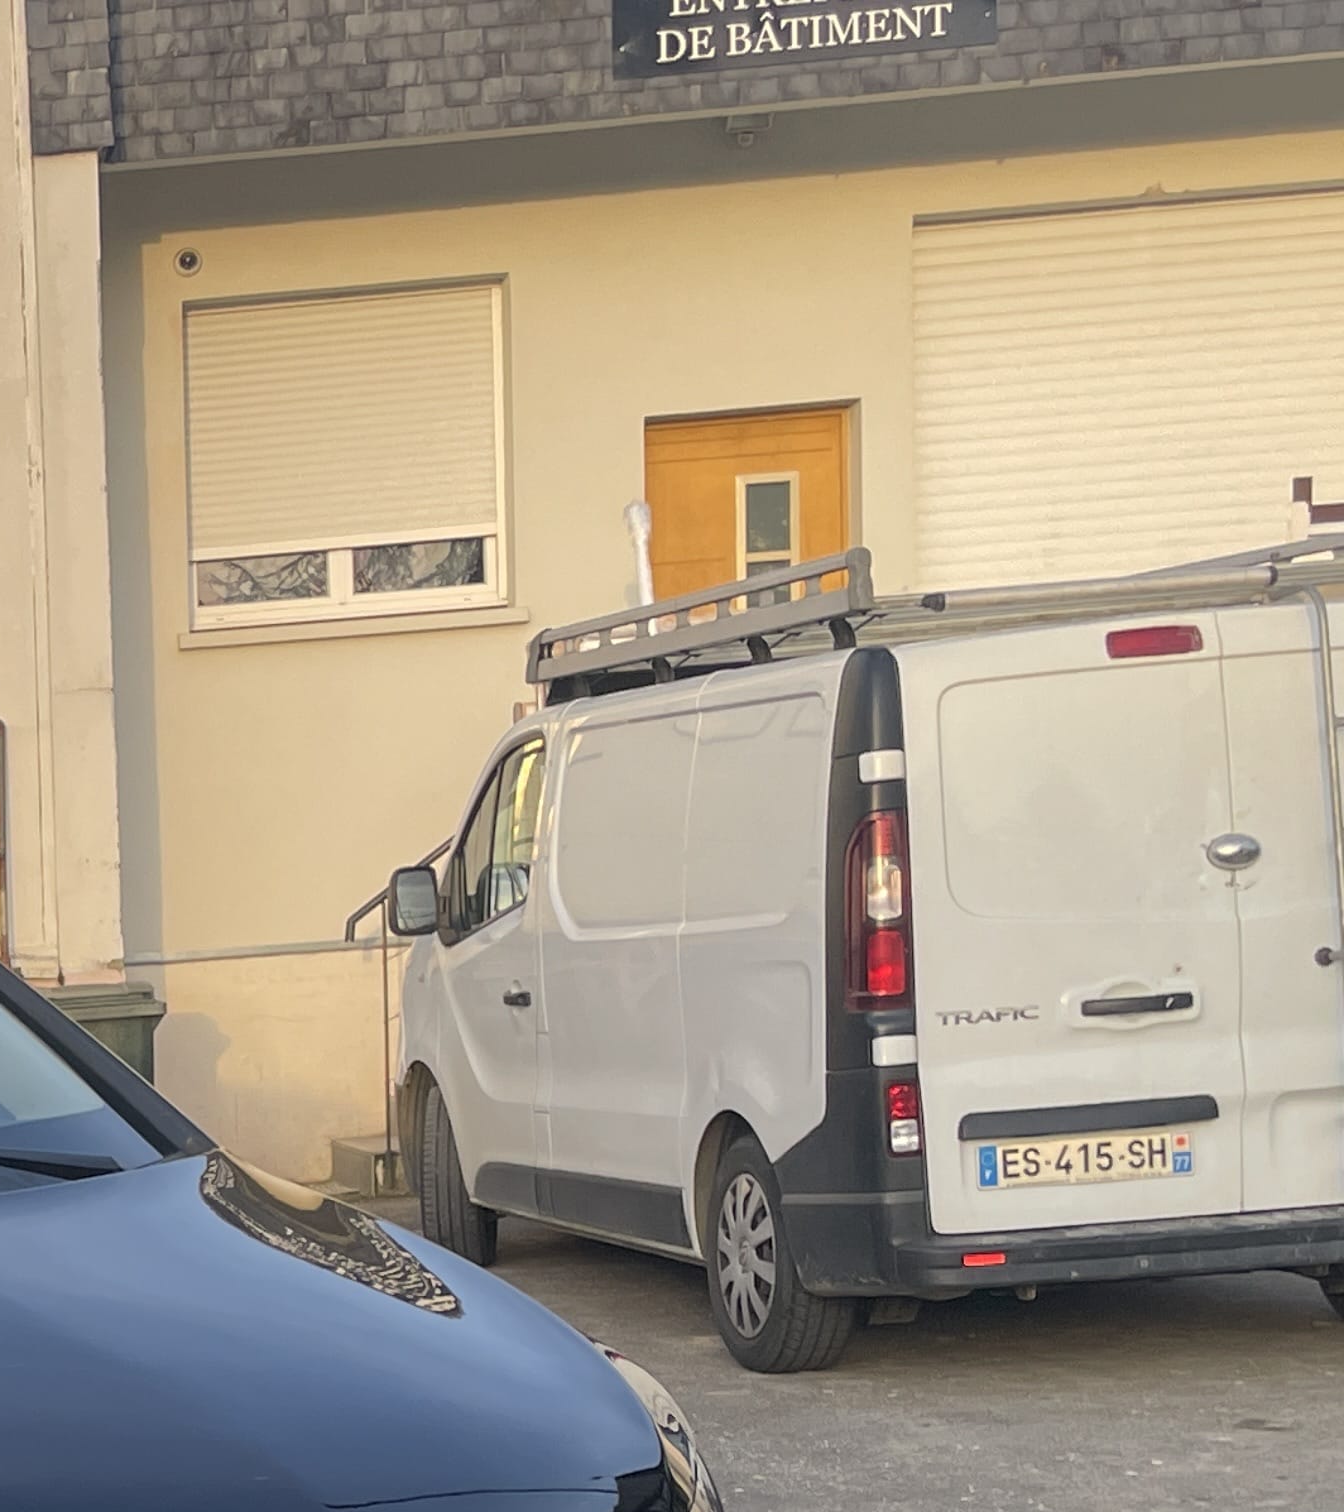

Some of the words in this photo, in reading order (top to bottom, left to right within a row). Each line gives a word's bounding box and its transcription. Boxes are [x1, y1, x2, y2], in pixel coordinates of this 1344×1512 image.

[655, 25, 716, 63] DE
[725, 2, 953, 58] BÂTIMENT
[934, 1003, 1040, 1026] TRAFIC
[1174, 1155, 1191, 1171] 77
